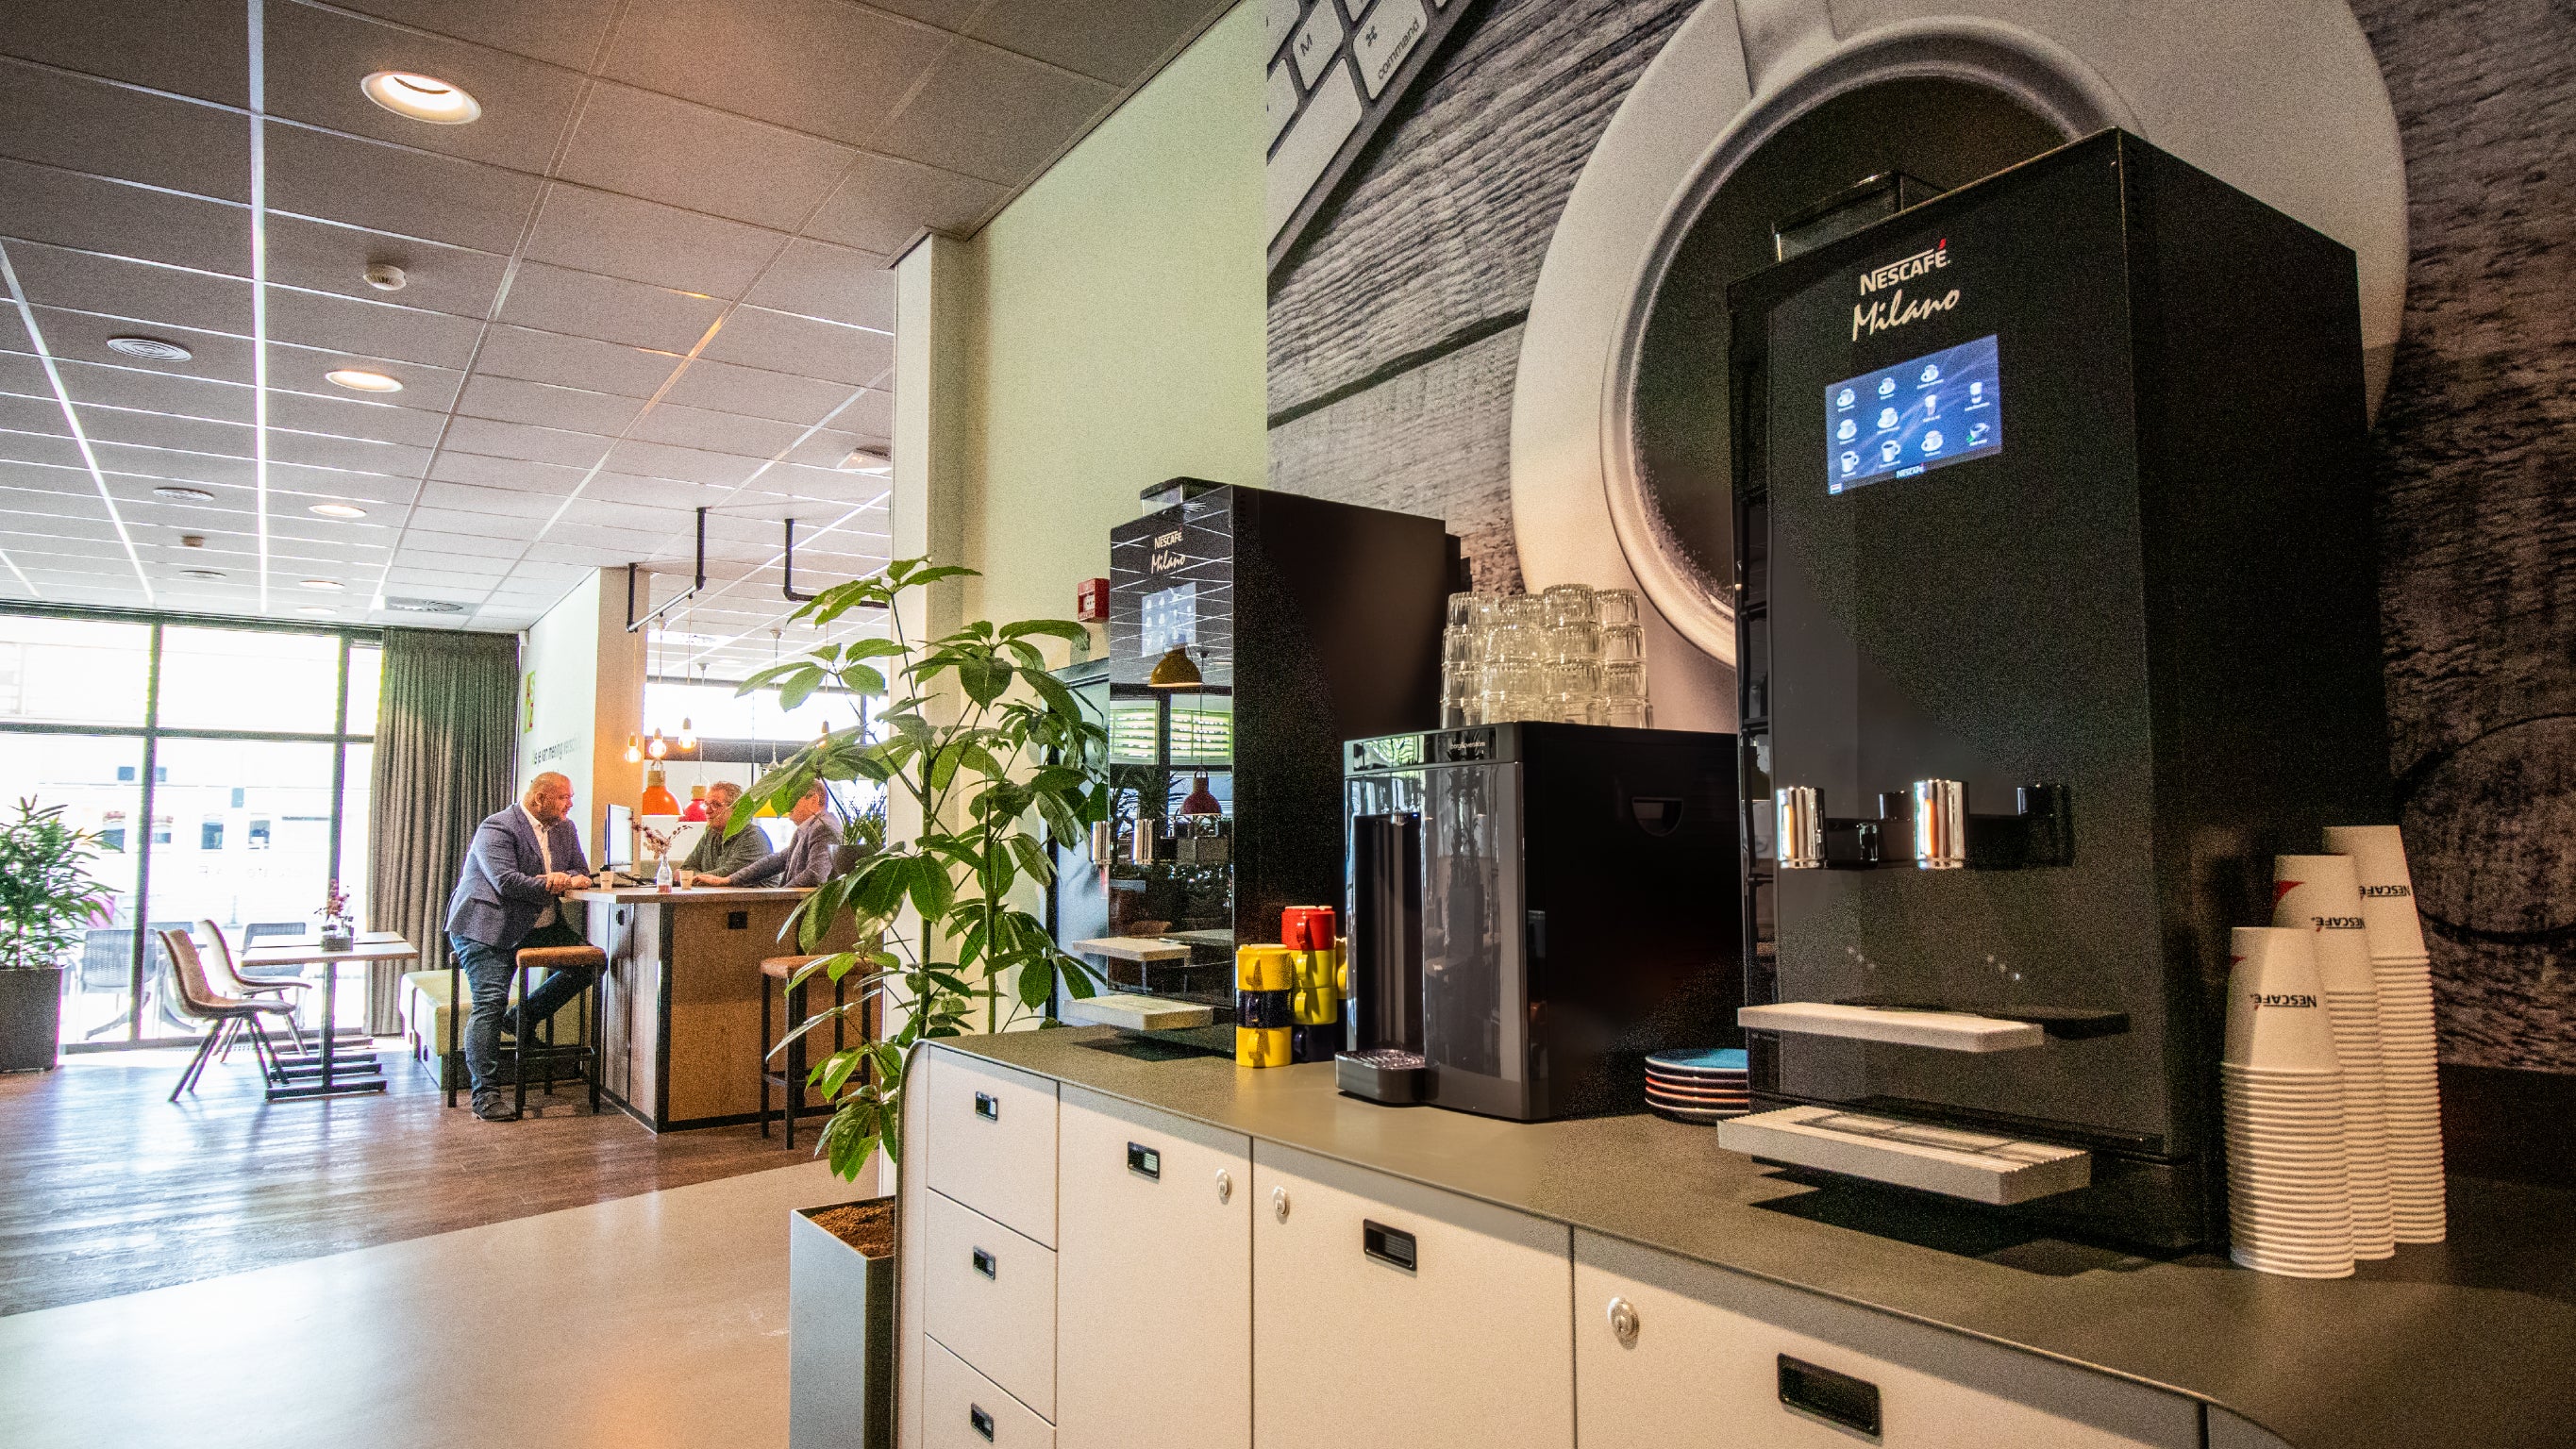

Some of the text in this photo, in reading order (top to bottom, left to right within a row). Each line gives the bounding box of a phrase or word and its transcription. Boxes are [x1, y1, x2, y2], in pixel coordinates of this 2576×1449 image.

[1299, 33, 1313, 57] M
[1378, 18, 1420, 80] command
[1860, 238, 1947, 296] NESCAFÉ
[1852, 289, 1960, 341] Milano
[1151, 550, 1186, 574] Milano
